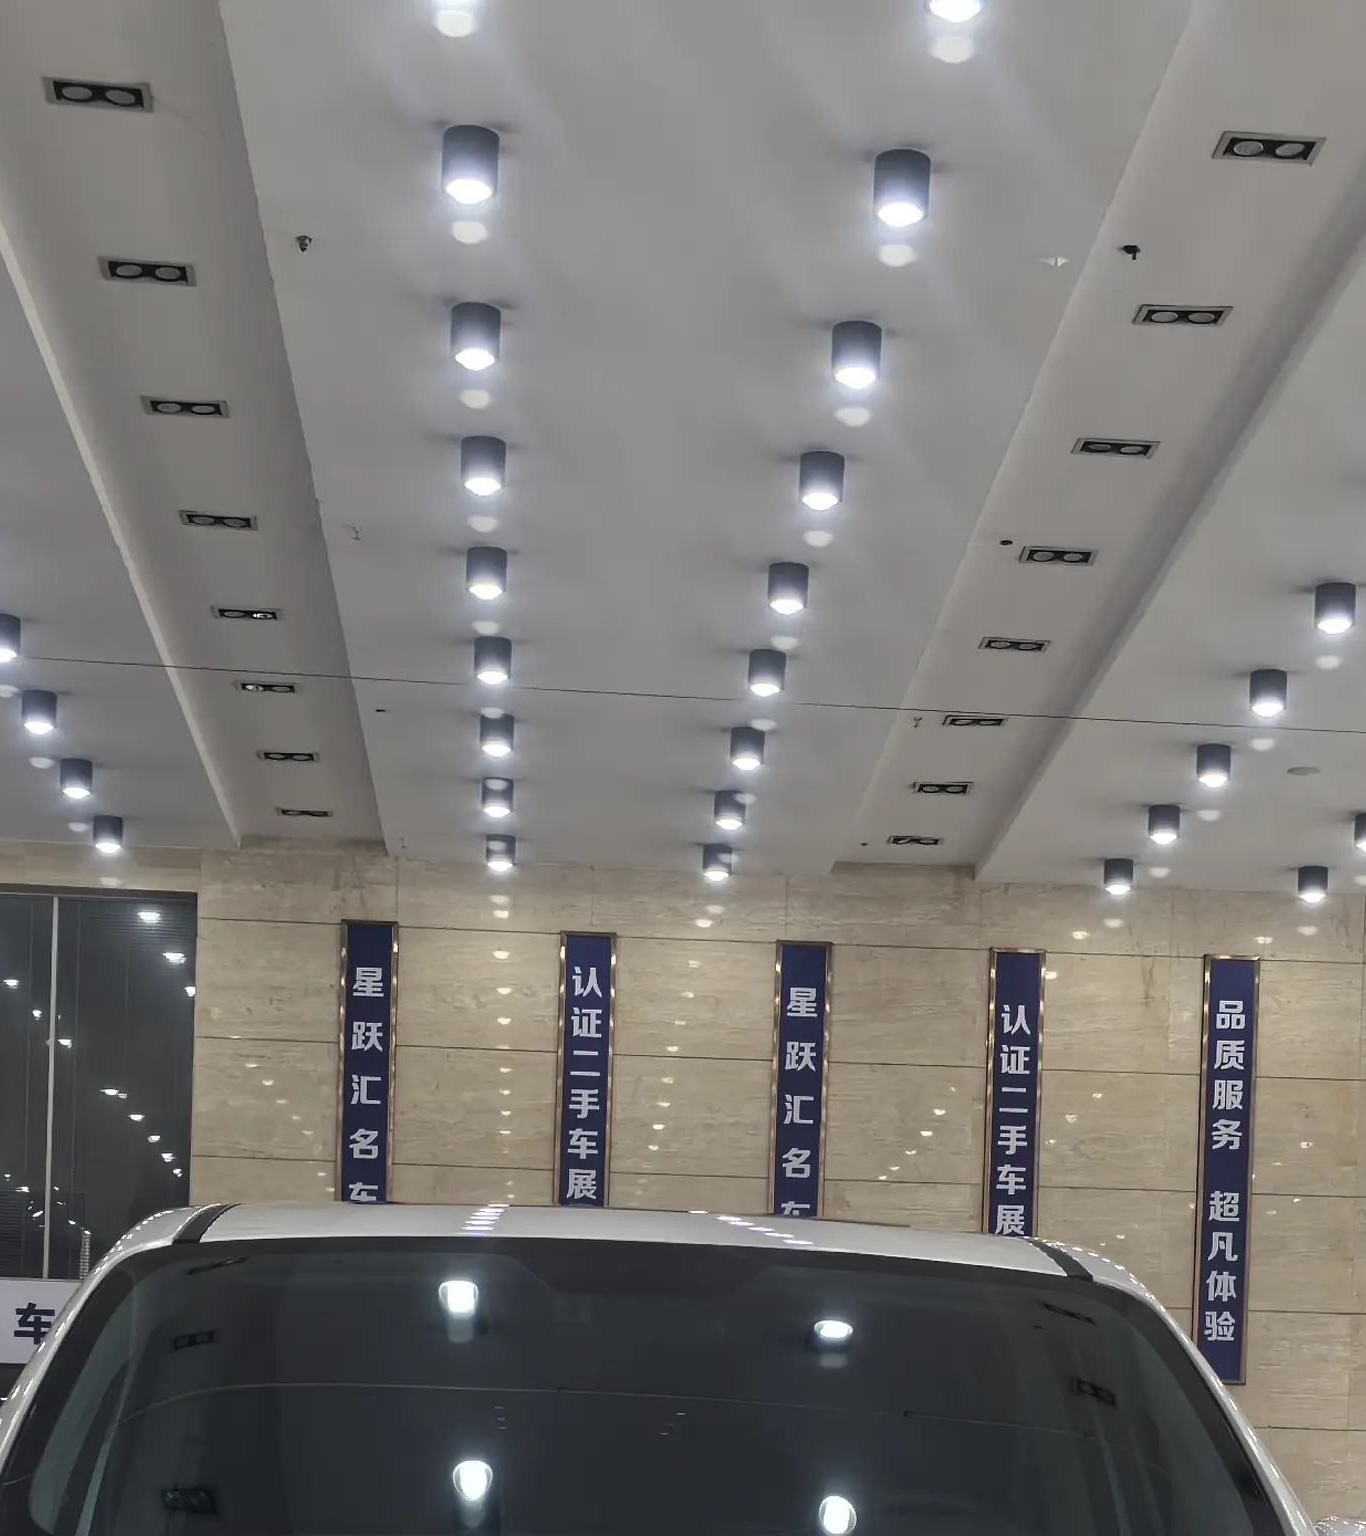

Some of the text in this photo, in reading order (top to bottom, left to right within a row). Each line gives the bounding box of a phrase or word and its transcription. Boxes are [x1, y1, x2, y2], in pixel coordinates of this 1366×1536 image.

[348, 967, 384, 1201] 星跃汇名车
[566, 966, 603, 1200] 认证二手车展
[995, 1004, 1031, 1237] 认证二手车展
[1203, 1000, 1246, 1342] 品质服务 超凡体验
